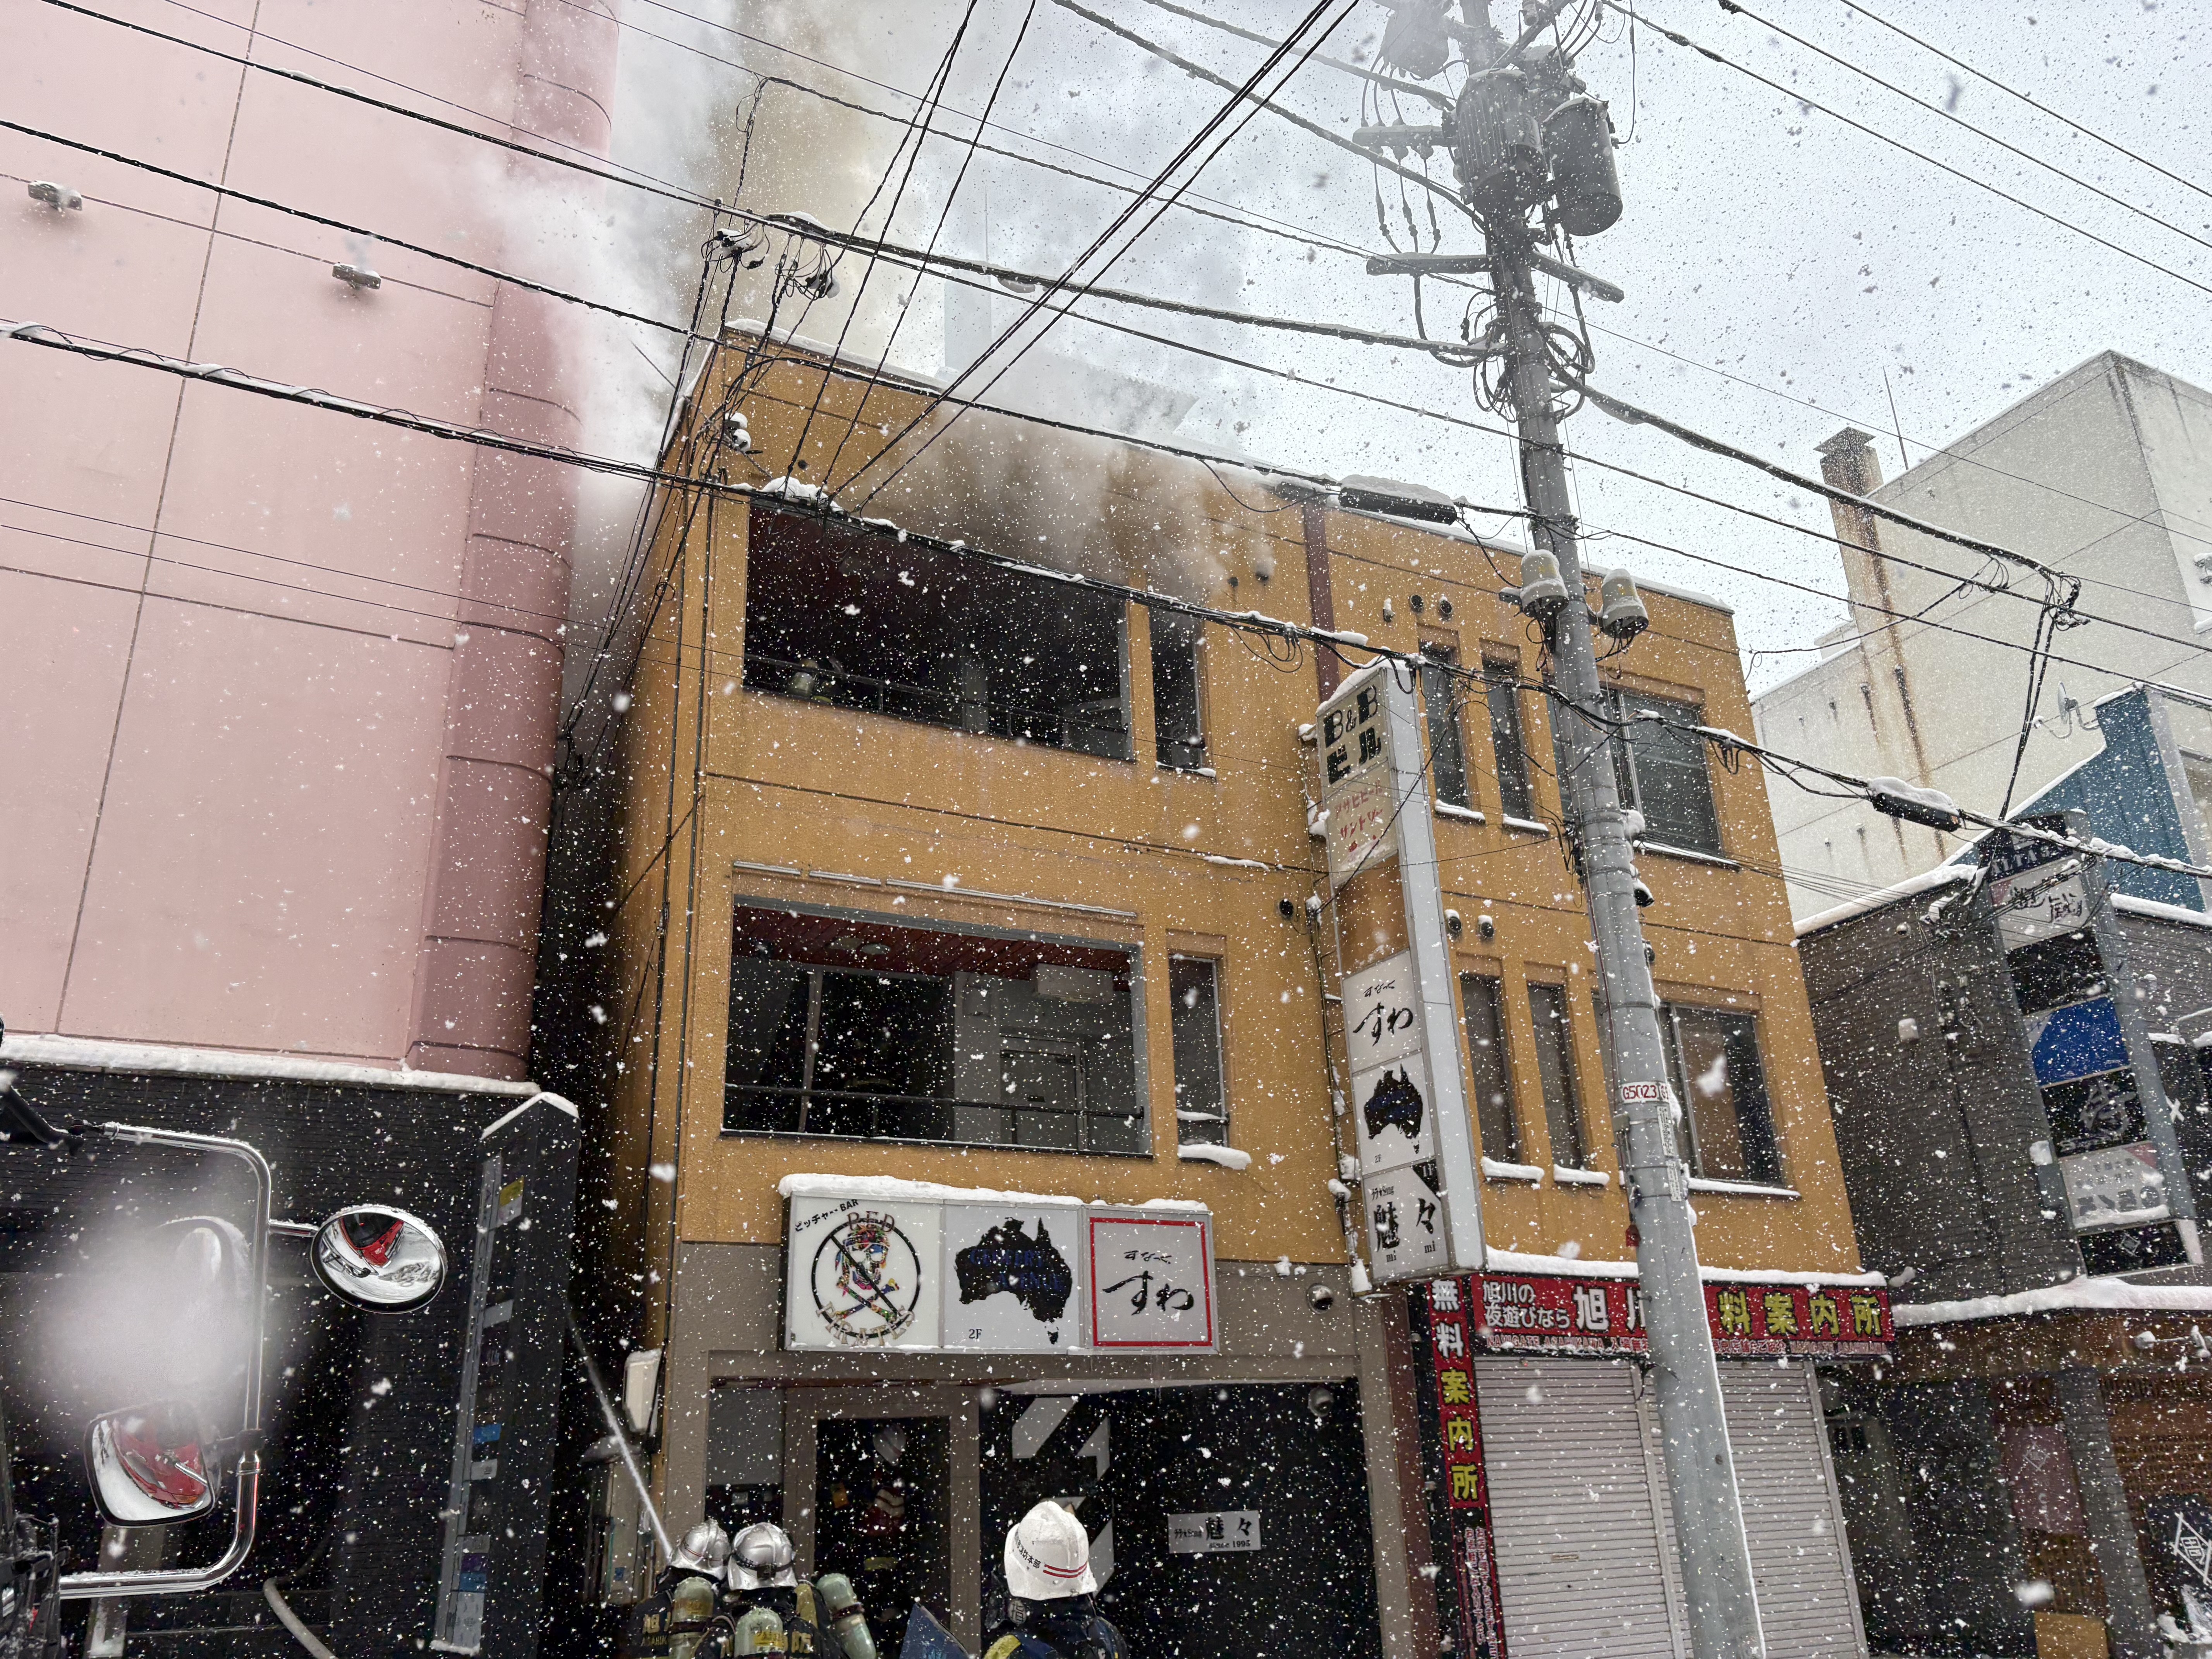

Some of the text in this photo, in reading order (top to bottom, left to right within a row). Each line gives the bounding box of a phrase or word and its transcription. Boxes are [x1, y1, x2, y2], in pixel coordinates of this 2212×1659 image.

[1327, 725, 1381, 785] ビル
[1353, 1001, 1413, 1046] すわ
[795, 1199, 859, 1232] ピッチャー BAR
[1102, 1270, 1194, 1316] すわ
[1483, 1280, 1536, 1304] 旭川の
[816, 1301, 915, 1346] PIRATES
[969, 1328, 982, 1339] 2F
[1484, 1302, 1571, 1329] 夜遊びなら
[1432, 1279, 1479, 1502] 無料案内所
